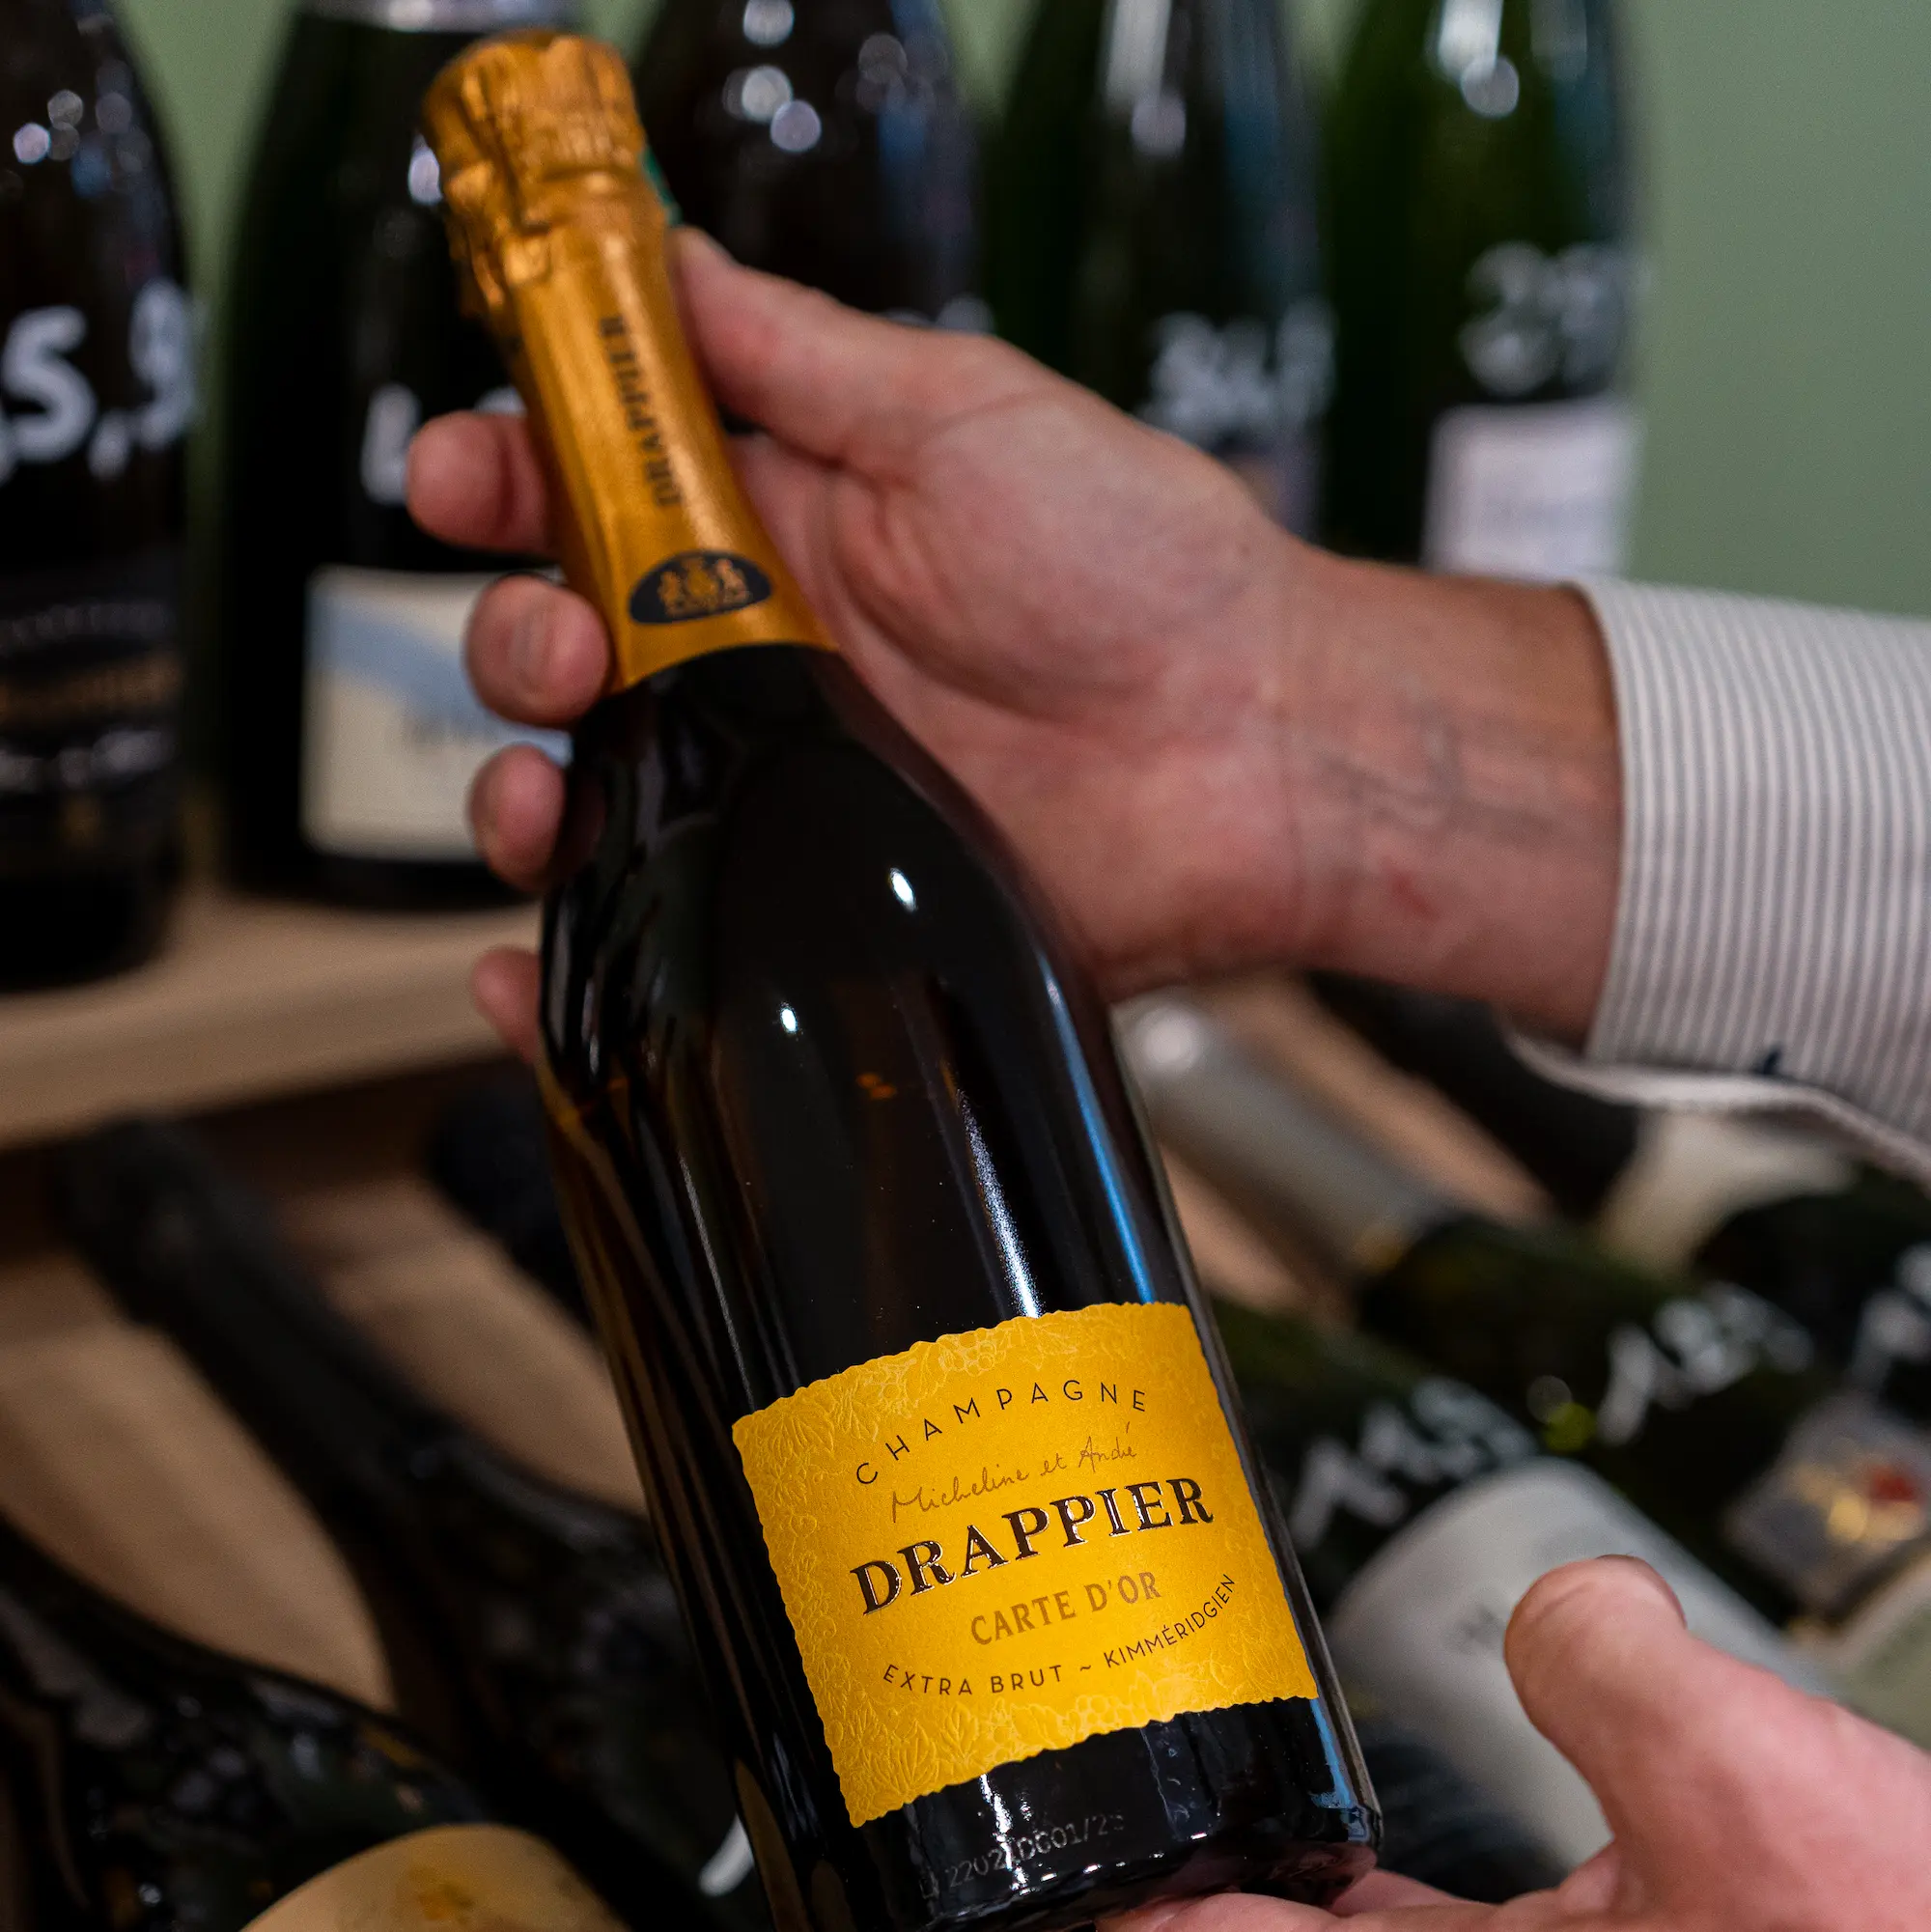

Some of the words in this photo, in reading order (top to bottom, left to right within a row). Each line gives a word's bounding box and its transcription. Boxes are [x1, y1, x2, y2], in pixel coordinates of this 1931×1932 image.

[855, 1379, 1147, 1486] CHAMPAGNE
[890, 1463, 1030, 1524] Micheline
[1039, 1455, 1068, 1476] et
[1078, 1420, 1137, 1473] André
[849, 1476, 1216, 1617] DRAPPIER
[882, 1664, 973, 1696] EXTRA
[990, 1664, 1062, 1694] BRUT
[1104, 1573, 1236, 1668] KIMMÉRIDGIEN
[970, 1589, 1077, 1646] CARTE
[1082, 1571, 1162, 1613] D'OR
